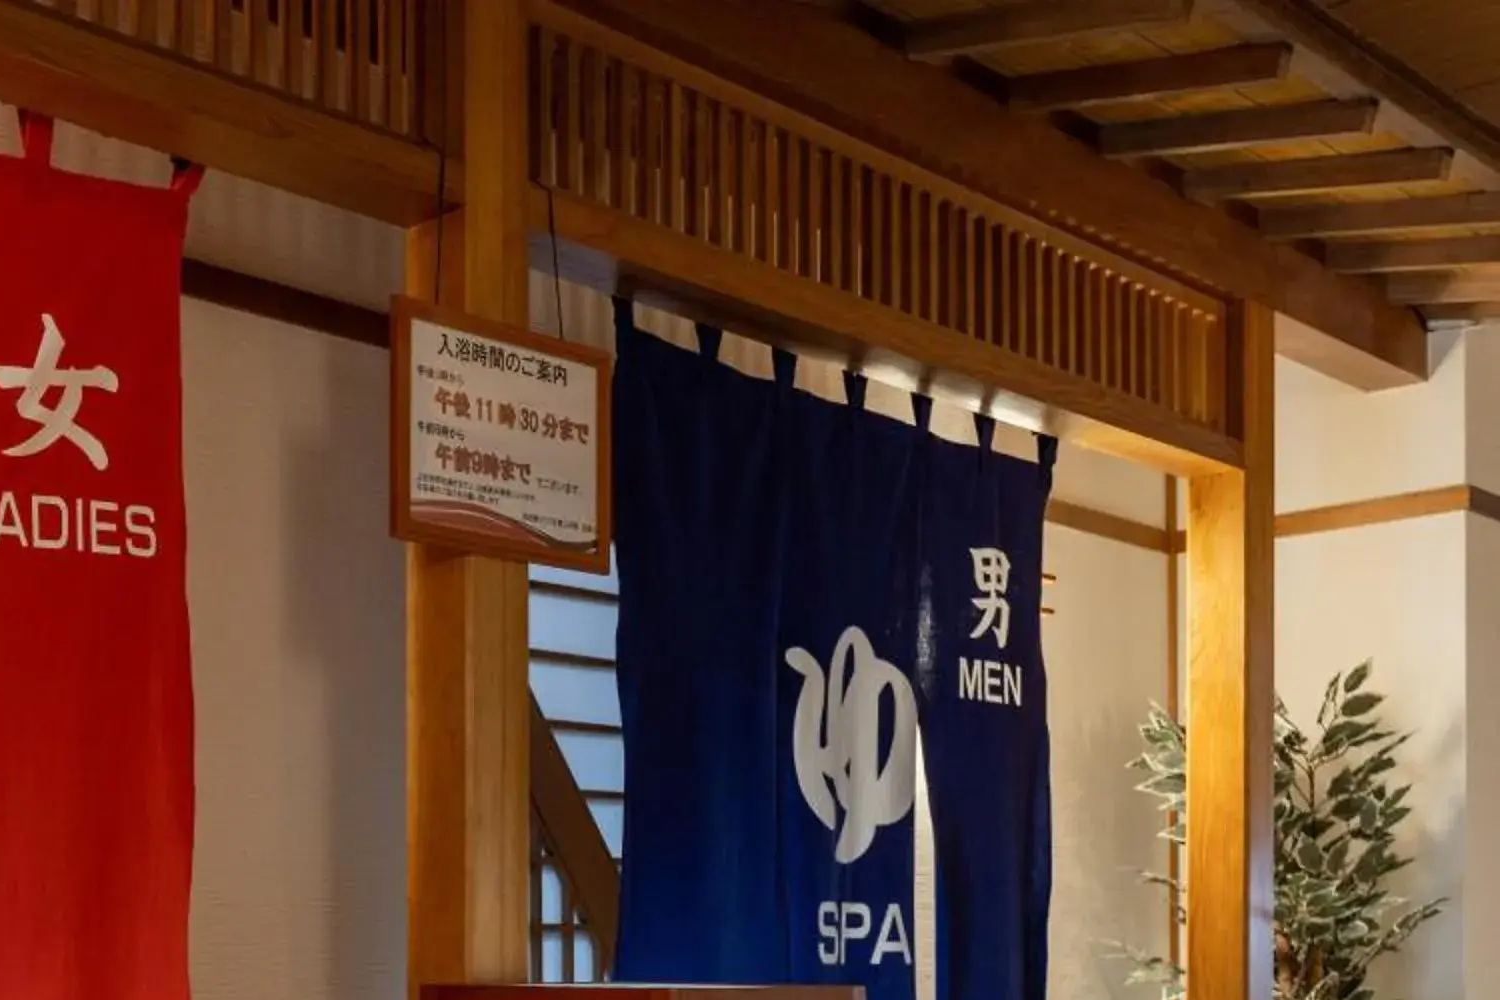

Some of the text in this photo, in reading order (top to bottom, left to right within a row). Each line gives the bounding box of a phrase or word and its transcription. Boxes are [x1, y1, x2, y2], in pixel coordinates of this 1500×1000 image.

[437, 333, 567, 387] 入浴時間のご案内
[968, 547, 1011, 649] 男
[958, 656, 1022, 706] MEN
[785, 625, 918, 864] ゆ
[817, 901, 912, 966] SPA
